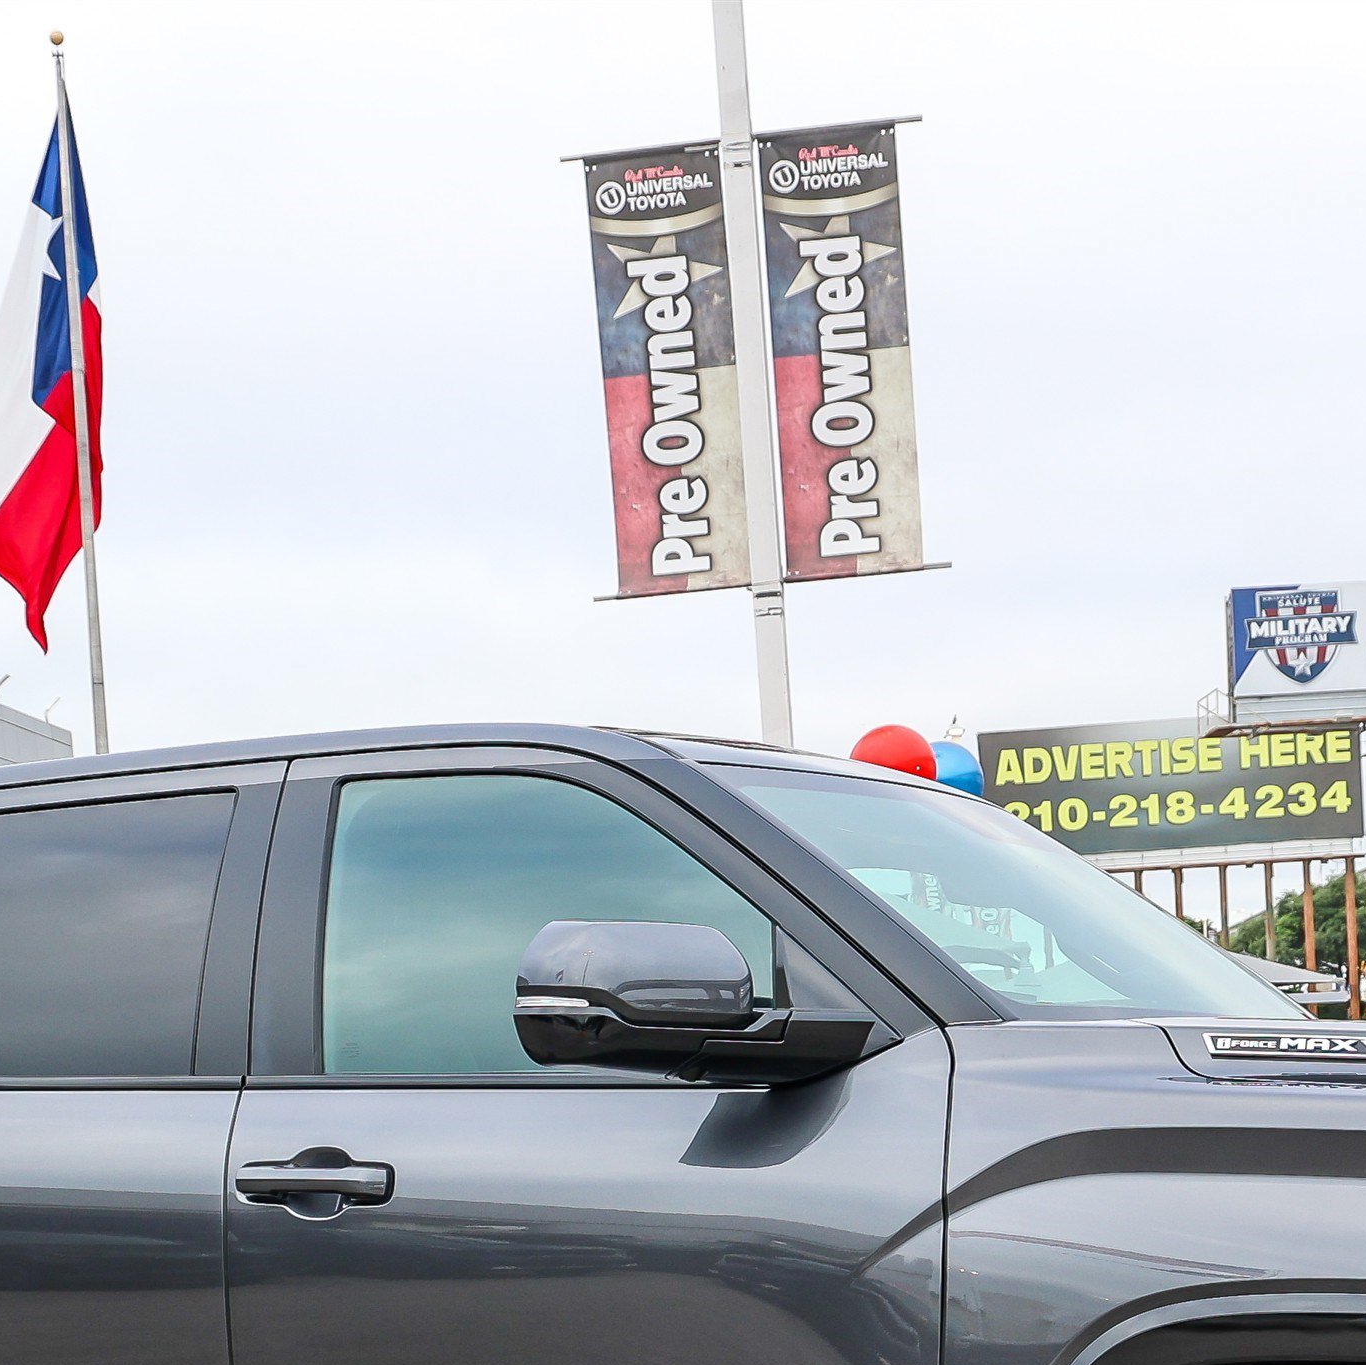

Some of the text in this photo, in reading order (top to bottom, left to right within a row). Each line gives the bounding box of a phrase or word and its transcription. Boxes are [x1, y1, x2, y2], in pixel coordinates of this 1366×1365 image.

[800, 152, 888, 175] UNIVERSAL
[626, 173, 713, 197] UNIVERSAL
[800, 171, 861, 191] TOYOTA
[626, 191, 687, 212] TOYOTA
[798, 234, 881, 558] Pre Owned
[626, 254, 712, 578] Pre Owned
[1278, 596, 1321, 607] SALUTE
[1249, 615, 1351, 639] MILITARY
[995, 730, 1352, 786] ADVERTISE HERE
[1003, 780, 1352, 832] 210-218-4234
[1279, 1037, 1358, 1052] MAX
